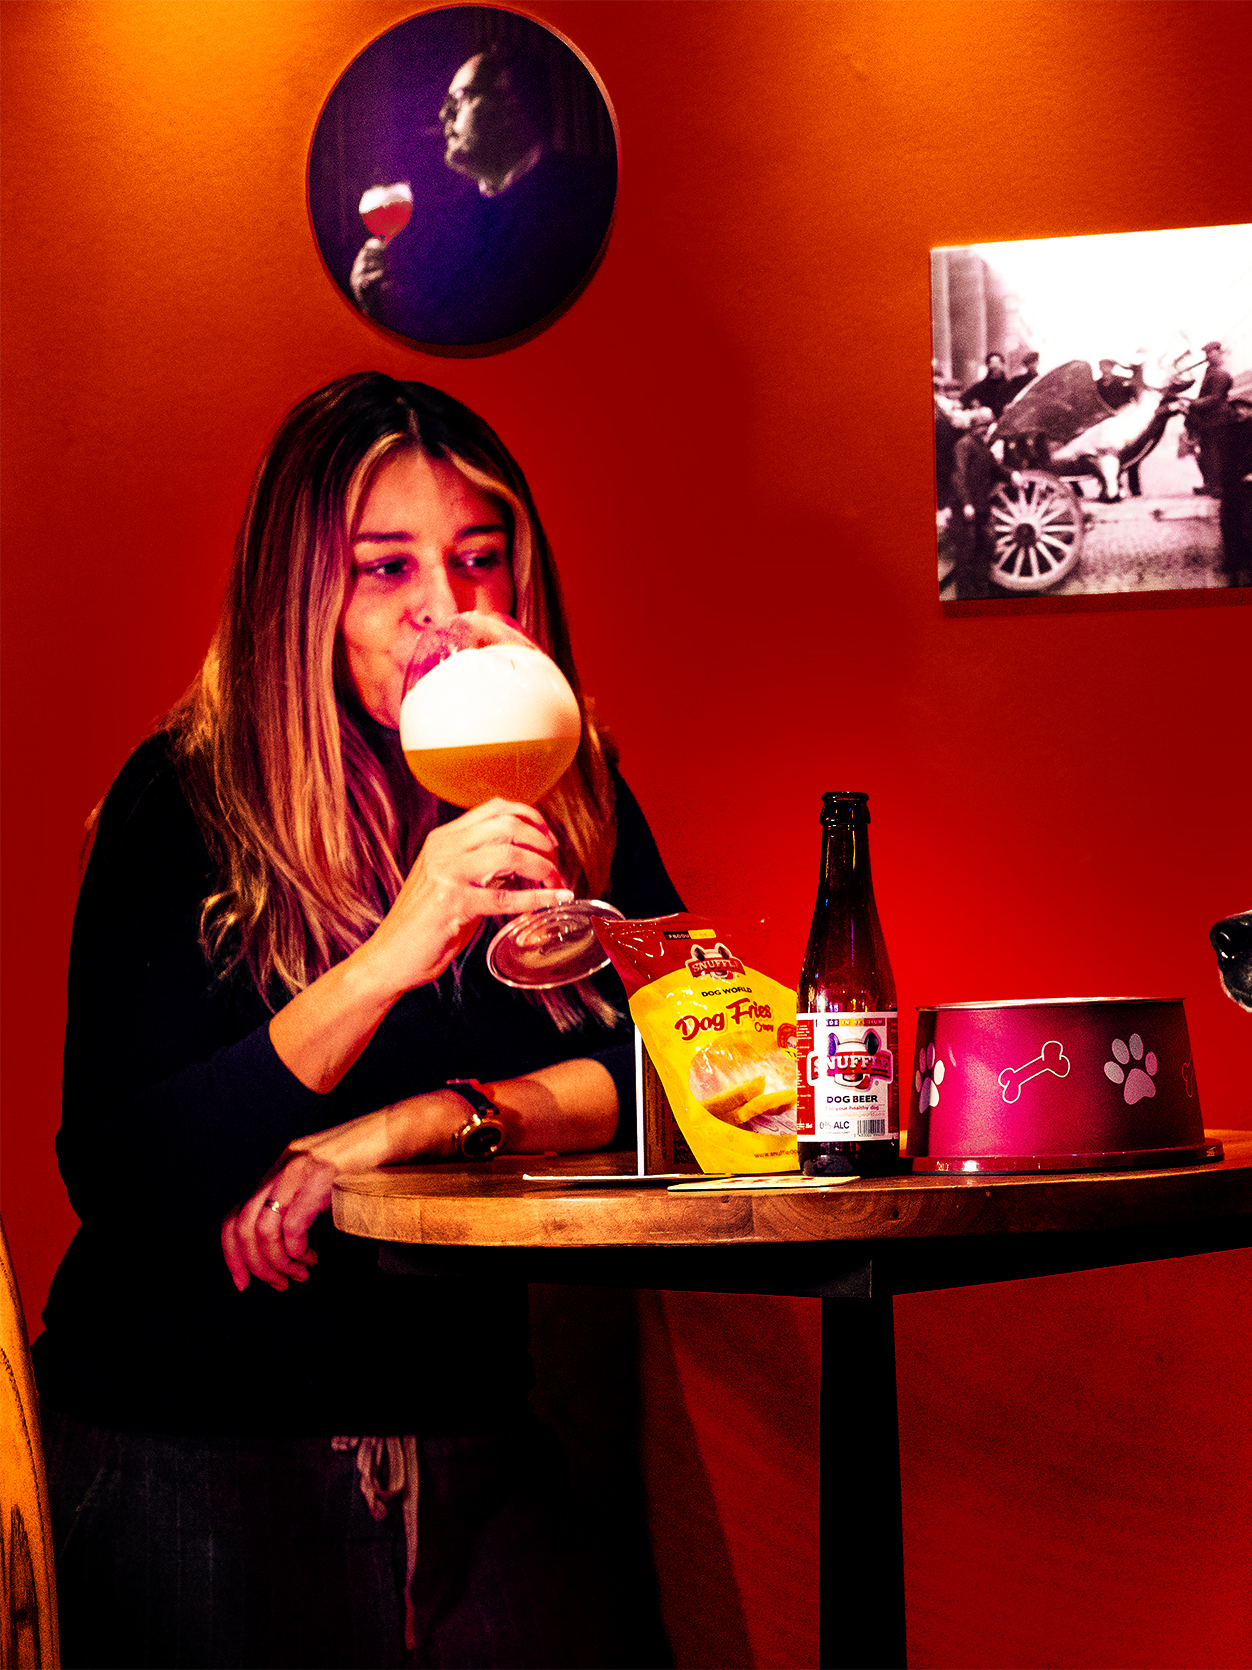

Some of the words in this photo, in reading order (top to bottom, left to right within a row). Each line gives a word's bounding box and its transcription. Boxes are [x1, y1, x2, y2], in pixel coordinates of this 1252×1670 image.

[701, 989, 721, 997] DOG
[723, 986, 752, 994] WORLD
[674, 1012, 724, 1040] Dog
[726, 998, 771, 1024] Fries
[826, 1095, 850, 1103] DOG
[853, 1095, 878, 1103] BEER
[819, 1121, 832, 1130] 0%
[833, 1120, 850, 1130] ALC
